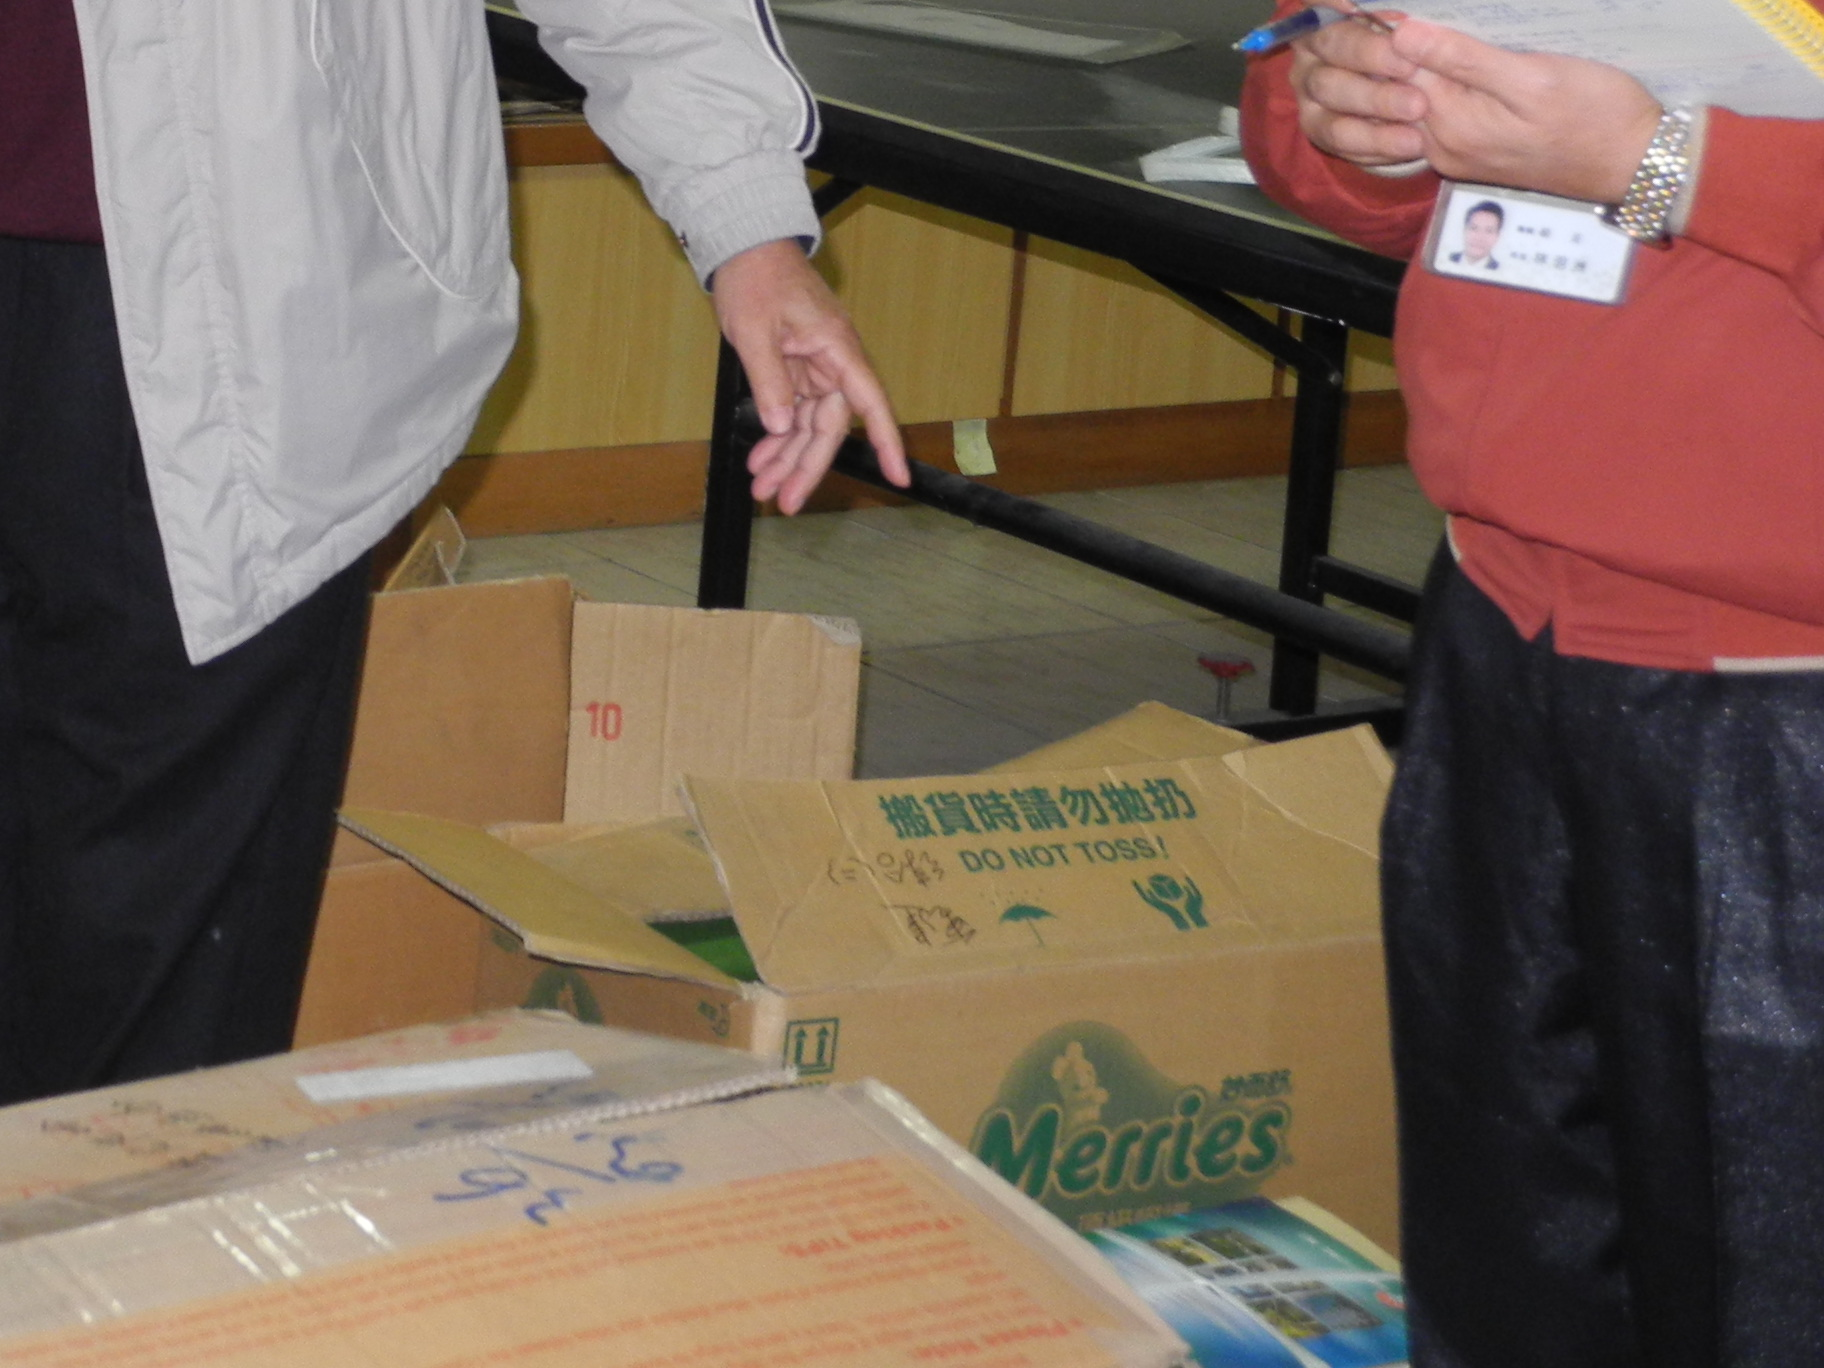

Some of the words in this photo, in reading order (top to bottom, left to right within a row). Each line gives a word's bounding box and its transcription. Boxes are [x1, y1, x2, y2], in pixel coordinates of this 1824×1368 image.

[585, 701, 622, 741] 10
[958, 848, 1006, 873] DO
[1008, 843, 1071, 869] NOT
[1074, 835, 1169, 863] TOSS!
[973, 1088, 1288, 1201] Merries
